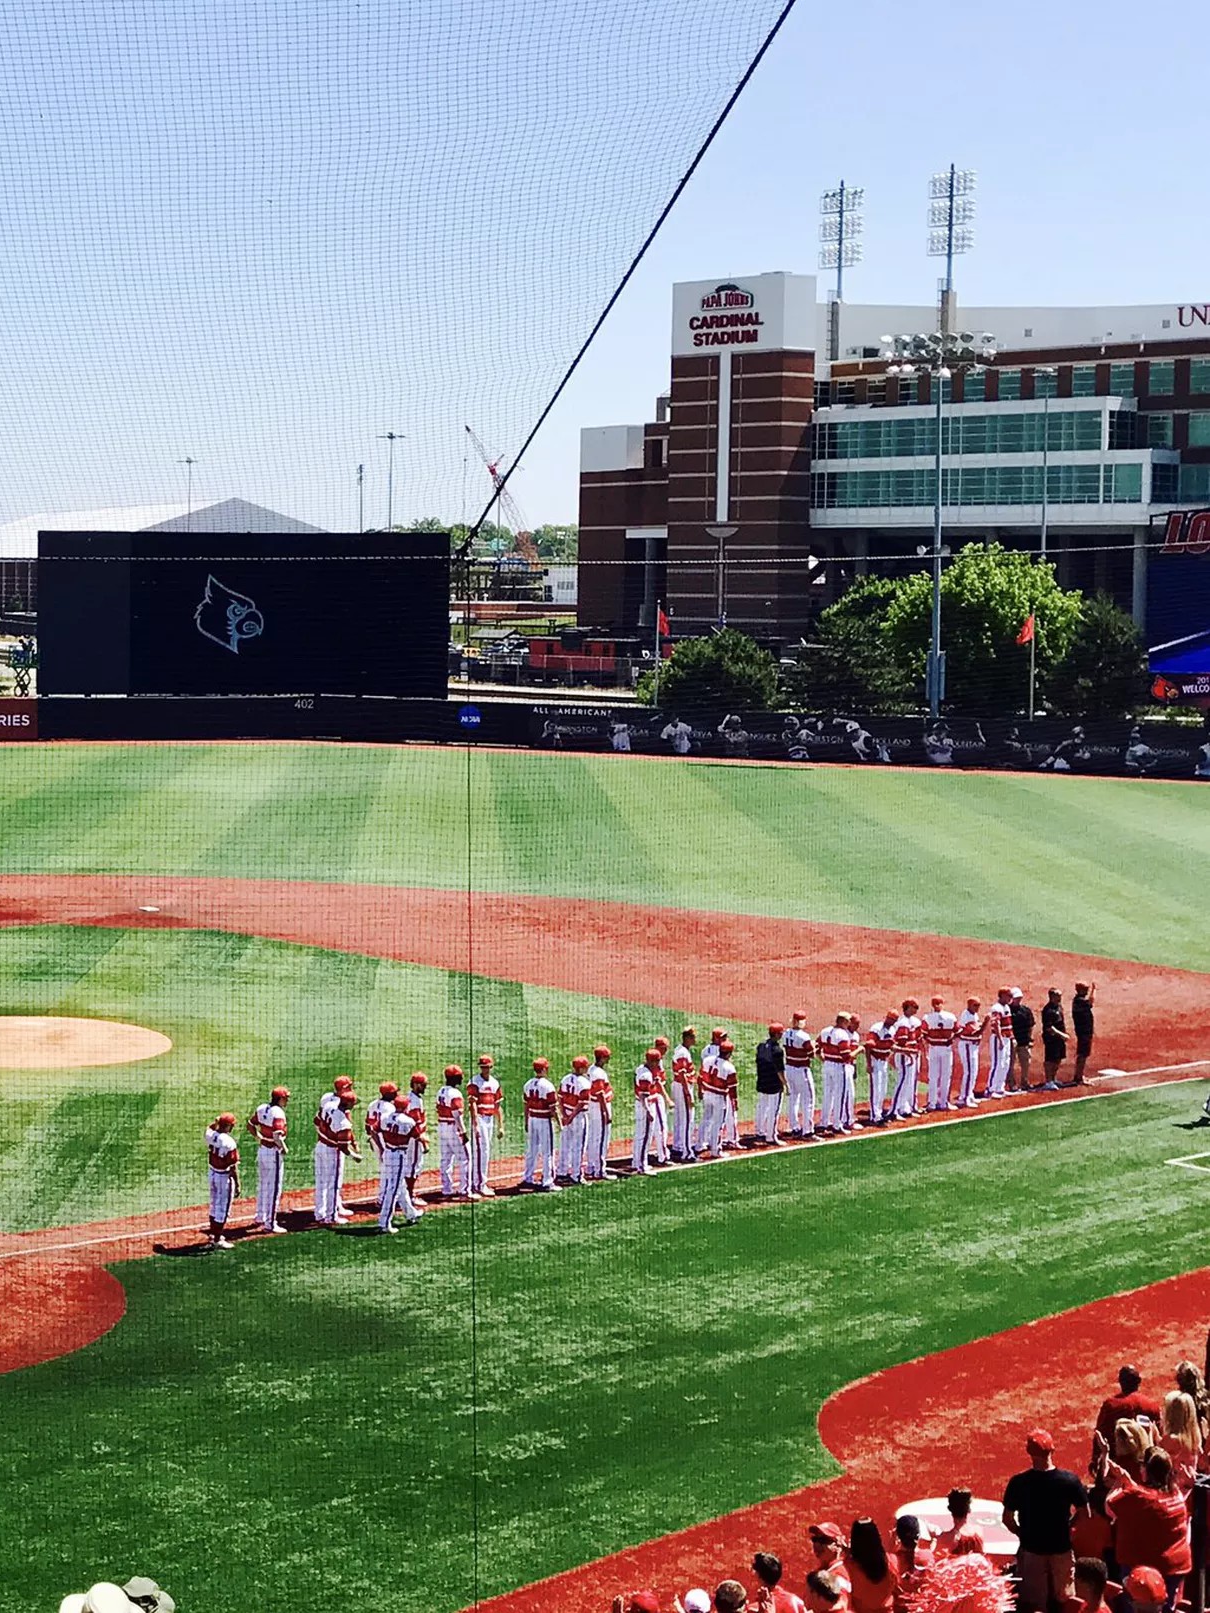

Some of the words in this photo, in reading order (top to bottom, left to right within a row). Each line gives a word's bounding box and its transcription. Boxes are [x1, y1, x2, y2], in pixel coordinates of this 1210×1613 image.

[701, 293, 722, 309] PAPA
[689, 312, 764, 331] CARDINAL
[1177, 304, 1210, 328] UN
[693, 329, 758, 347] STADIUM
[294, 699, 314, 709] 402
